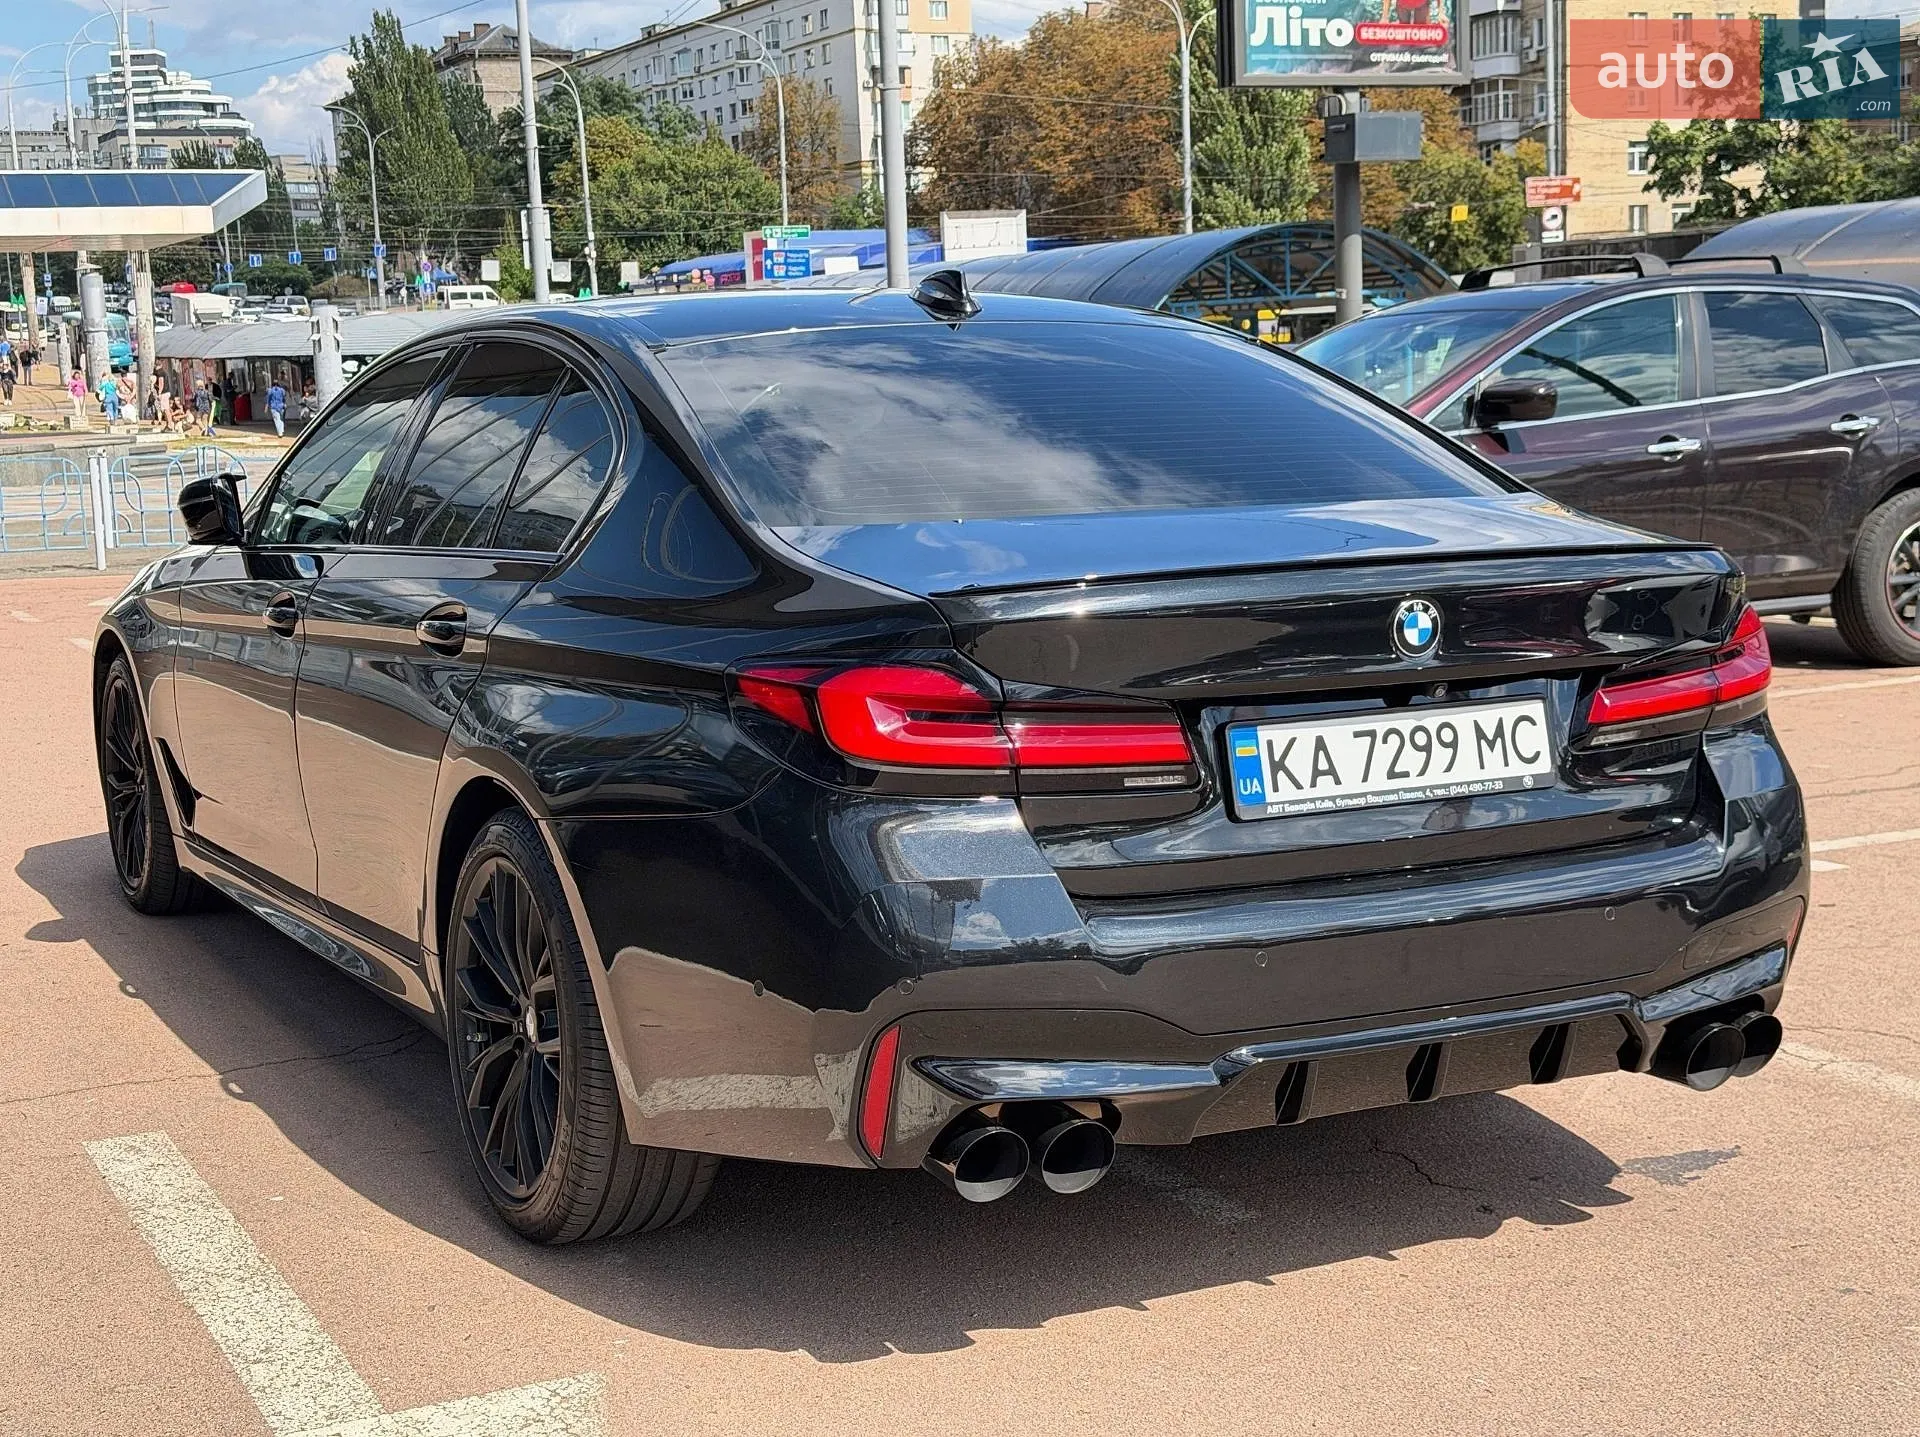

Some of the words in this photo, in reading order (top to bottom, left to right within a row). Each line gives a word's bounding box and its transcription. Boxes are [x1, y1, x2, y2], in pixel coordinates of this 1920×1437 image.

[1250, 5, 1354, 47] Літо
[1360, 26, 1444, 41] БЕЗКОШТОВНО
[1400, 602, 1437, 620] BMW
[1266, 735, 1342, 793] KA
[1352, 721, 1459, 783] 7299
[1473, 714, 1542, 770] MC
[1239, 777, 1263, 795] UA
[1468, 780, 1503, 792] 490-77-33
